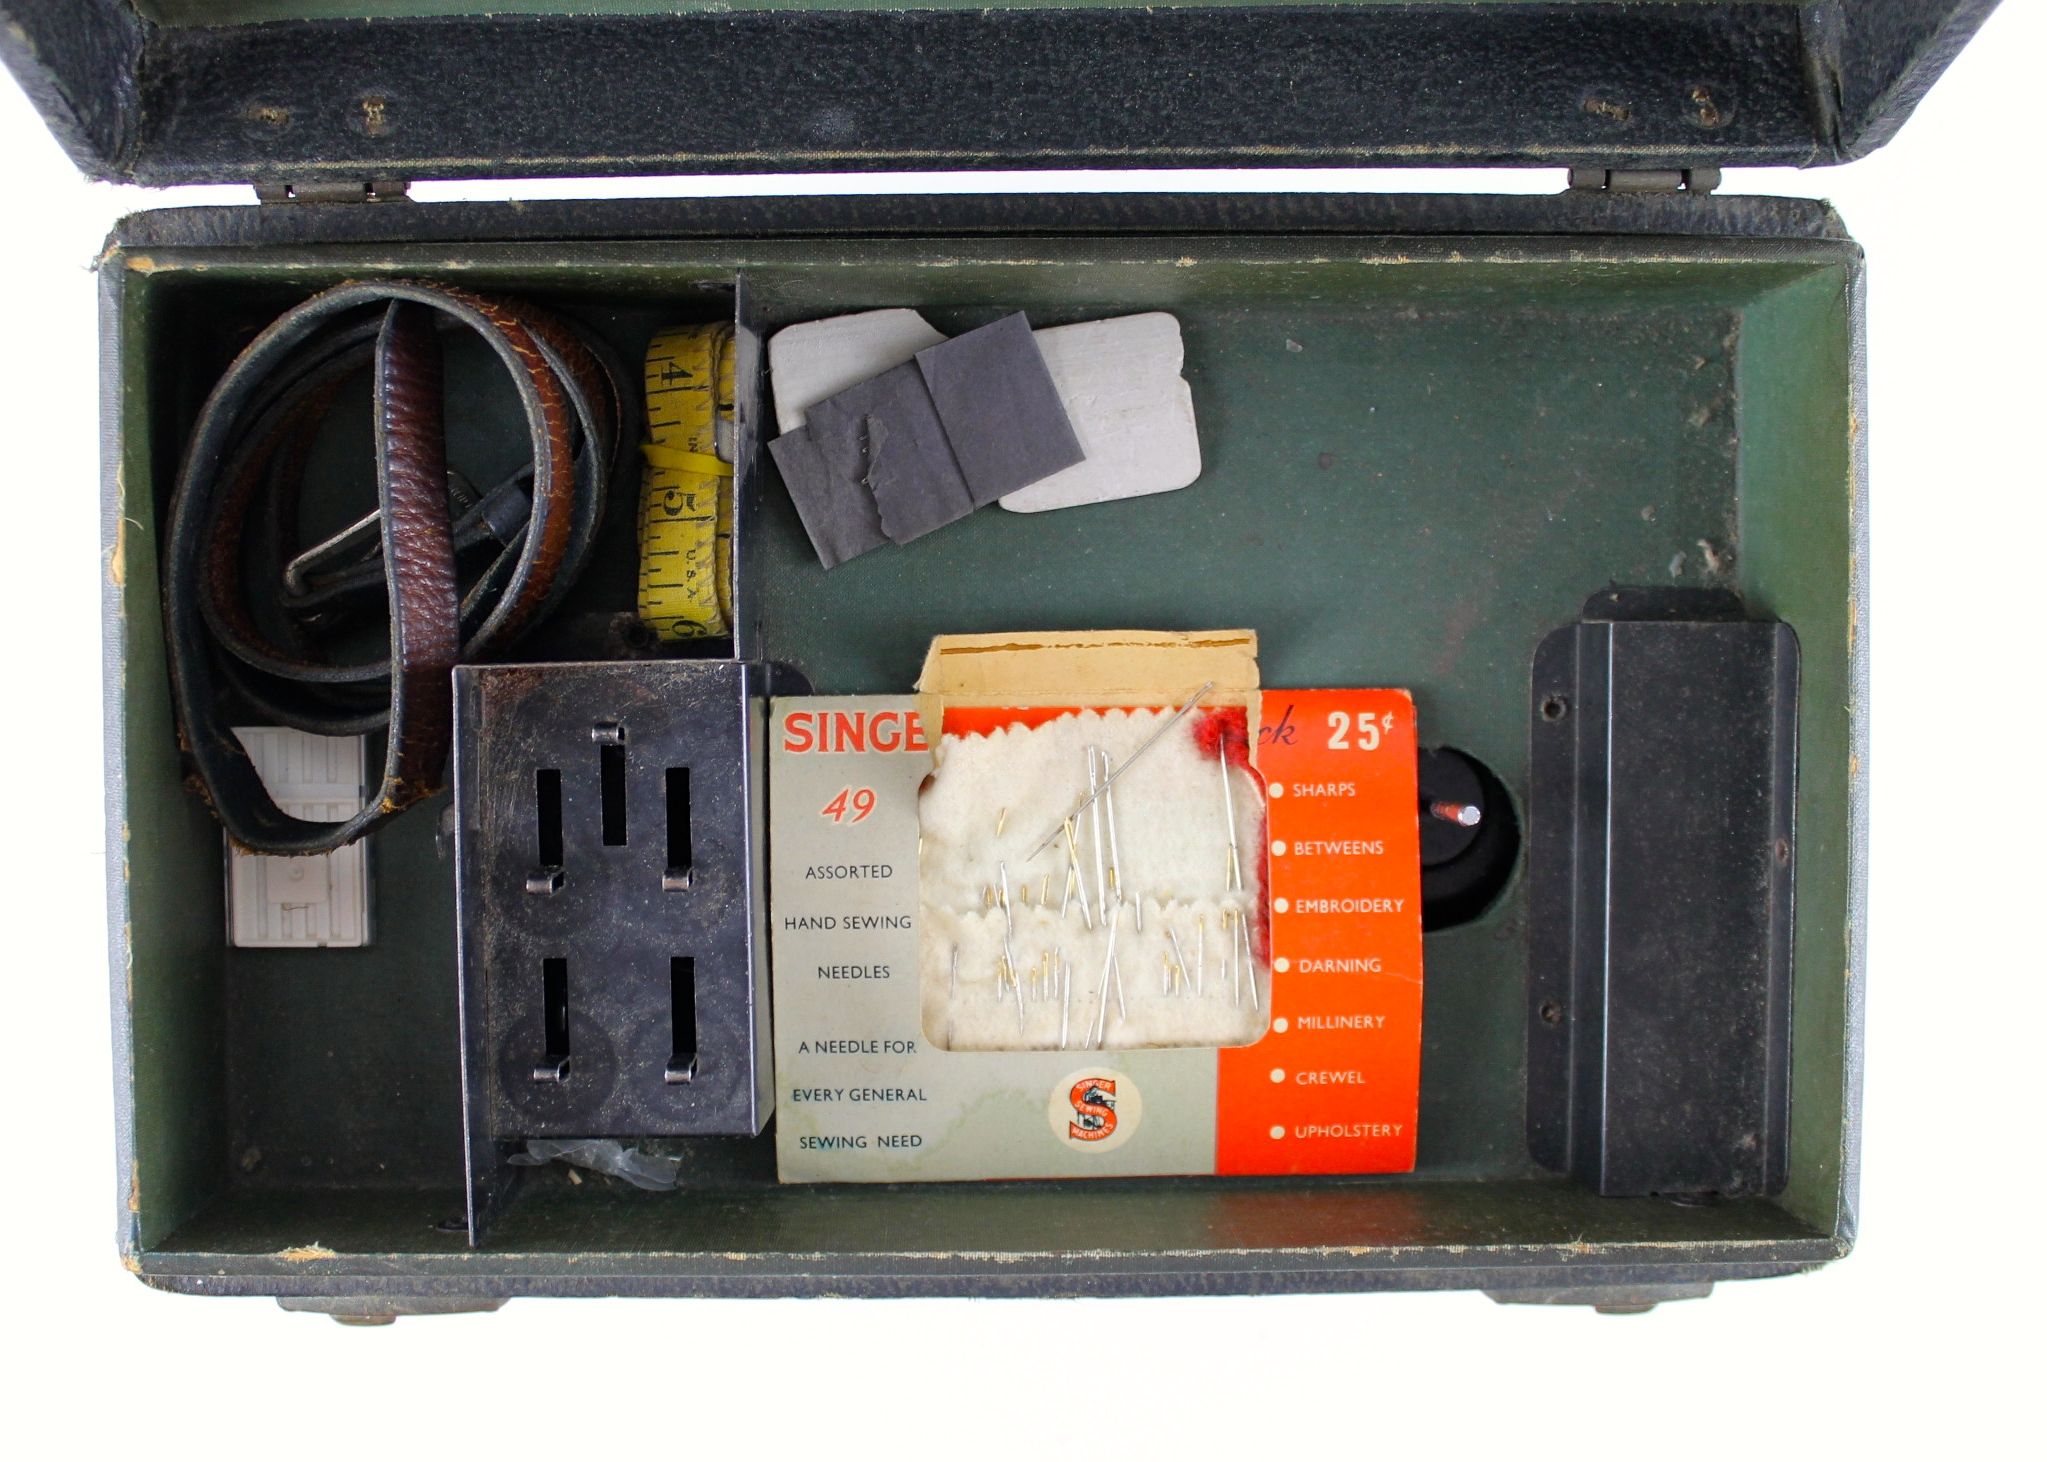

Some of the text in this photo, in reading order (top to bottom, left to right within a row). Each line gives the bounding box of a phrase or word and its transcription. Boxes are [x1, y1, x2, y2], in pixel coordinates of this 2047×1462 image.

[661, 361, 693, 386] 4
[663, 490, 697, 516] 5
[671, 619, 708, 638] 6
[784, 711, 929, 753] SINGE
[1258, 704, 1298, 746] ck
[1293, 783, 1356, 798] SHARPS
[820, 787, 877, 825] 49
[1294, 841, 1384, 856] BETWEENS
[805, 864, 893, 880] ASSORTED
[1295, 898, 1405, 914] EMBROIDERY
[784, 915, 912, 931] HAND SEWING
[817, 965, 891, 980] NEEDLES
[1299, 958, 1382, 974] DARNING
[1297, 1015, 1386, 1030] MILLINERY
[798, 1040, 918, 1055] A NEEDLE FOR
[1295, 1071, 1366, 1086] CREWEL
[792, 1088, 928, 1102] EVERY GENERAL
[1074, 1101, 1109, 1117] SEWING
[1294, 1124, 1403, 1140] UPHOLSTERY
[799, 1134, 923, 1150] SEWING NEED
